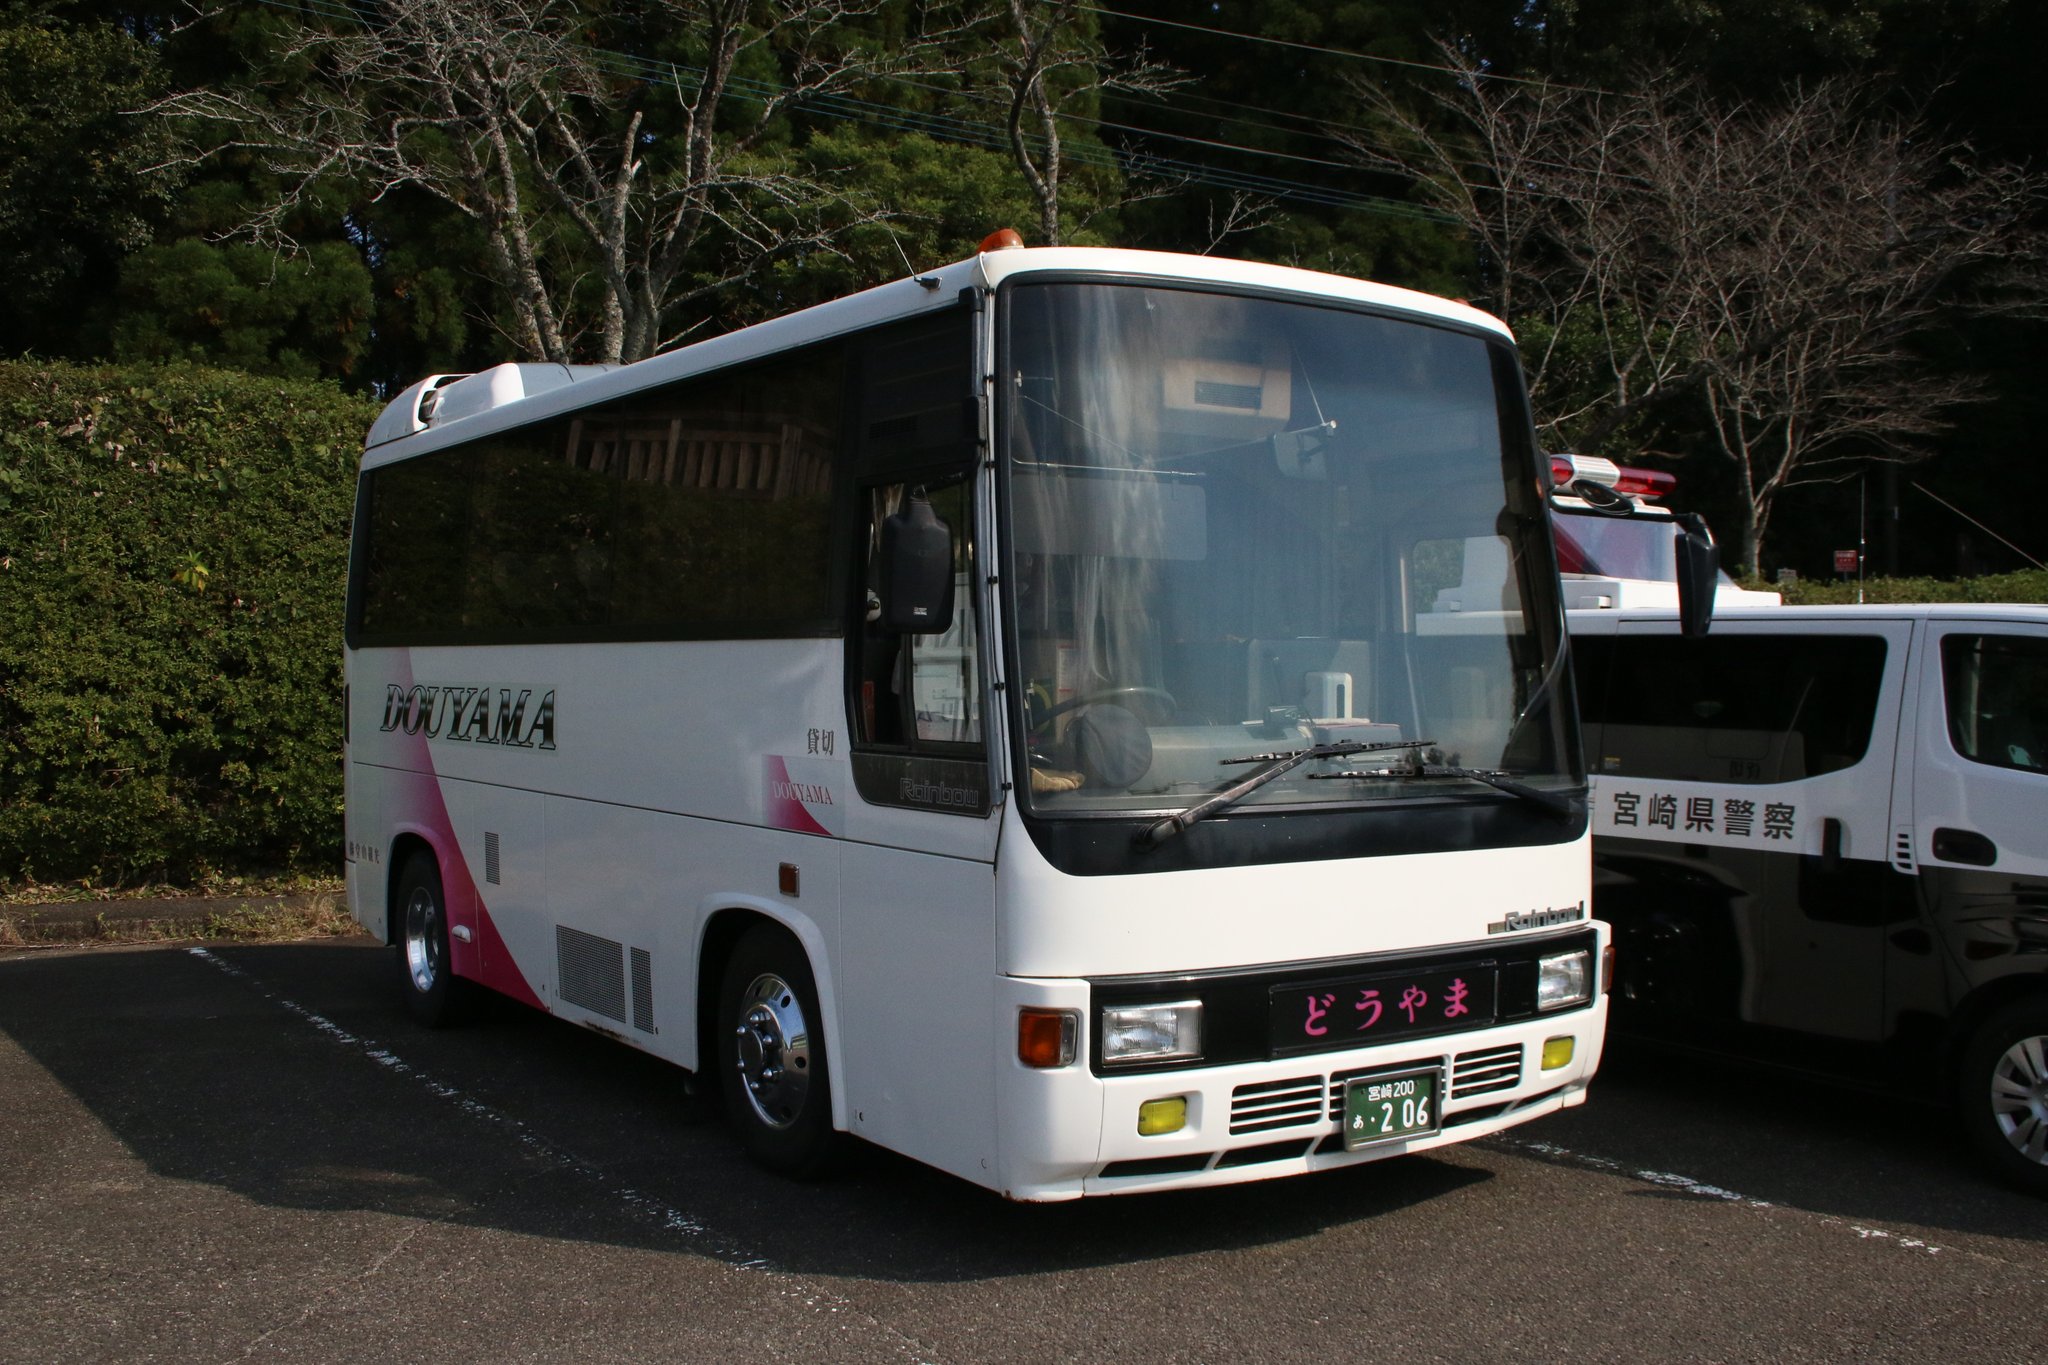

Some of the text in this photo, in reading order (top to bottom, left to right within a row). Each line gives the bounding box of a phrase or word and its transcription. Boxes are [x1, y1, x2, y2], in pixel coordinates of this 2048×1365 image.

[380, 684, 556, 750] DOUYAMA
[806, 727, 835, 756] 貸切
[772, 780, 834, 806] DOUYAMA
[900, 777, 979, 808] Rainbow
[1613, 791, 1796, 840] 宮崎県警察
[1503, 902, 1581, 932] Rainbow
[1304, 977, 1469, 1036] どうやま
[1353, 1114, 1364, 1129] あ
